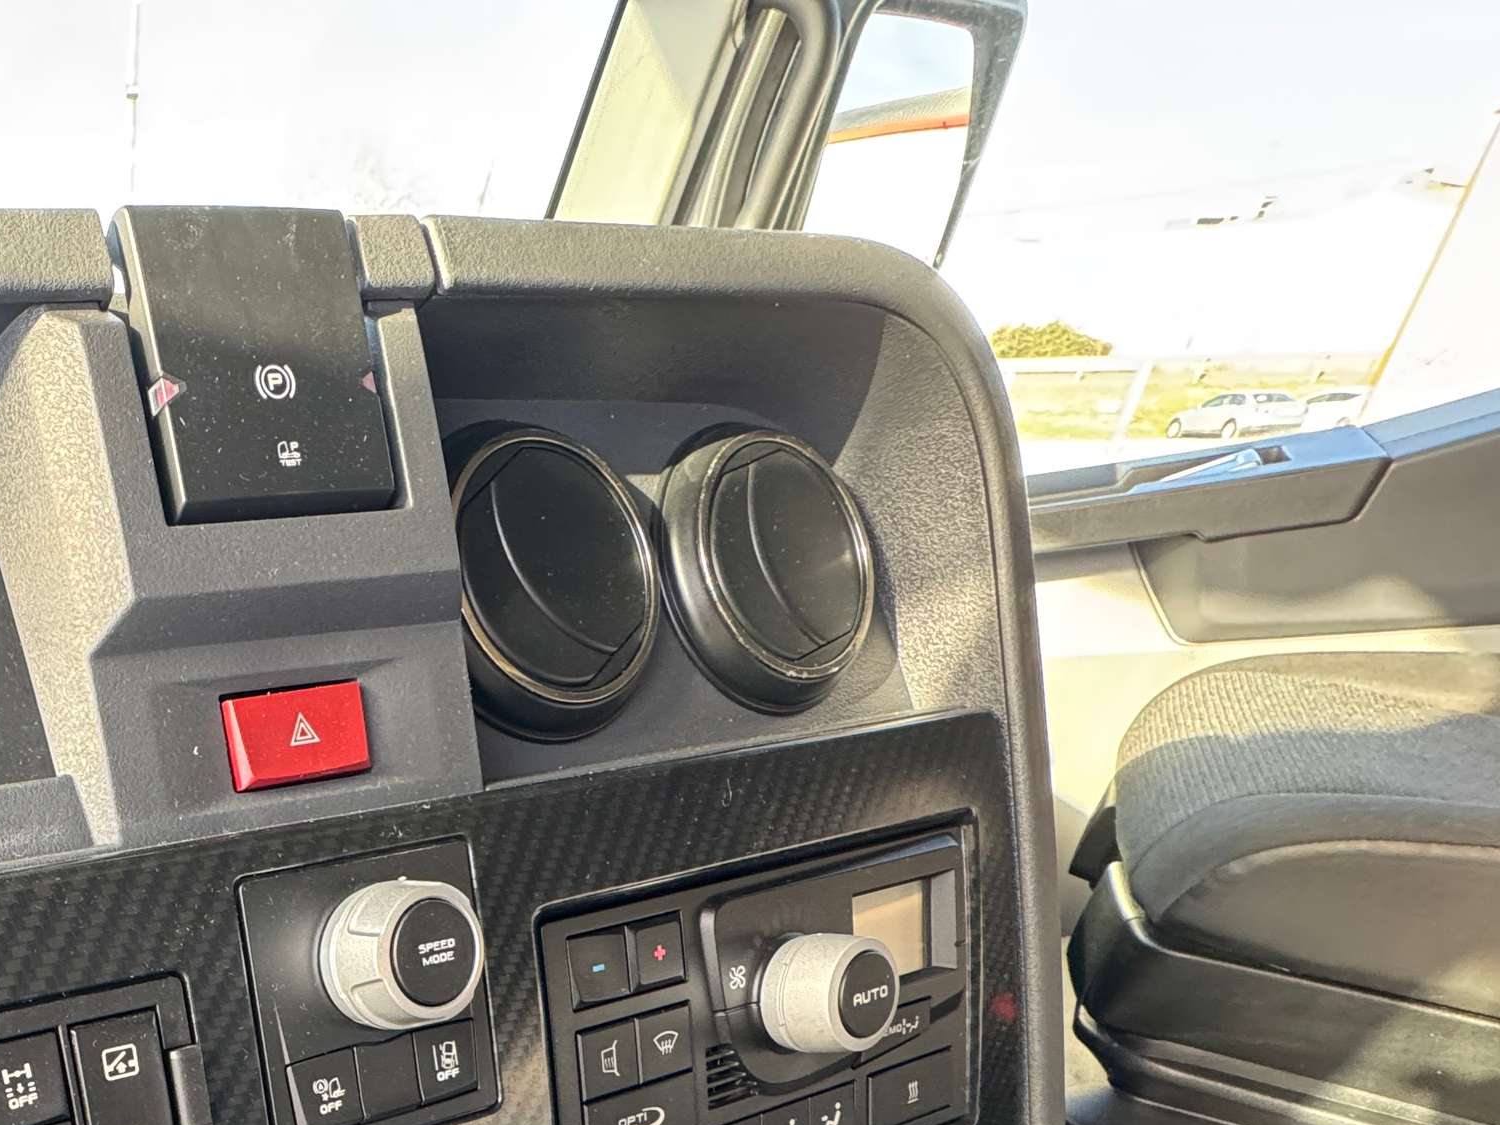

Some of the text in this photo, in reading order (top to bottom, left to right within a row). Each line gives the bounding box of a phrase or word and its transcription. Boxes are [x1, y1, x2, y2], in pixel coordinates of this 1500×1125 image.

[279, 458, 303, 467] TEST
[417, 937, 456, 955] SPEED
[421, 950, 455, 967] MODE
[852, 984, 889, 1007] AUTO
[436, 1067, 460, 1082] OFF
[9, 1093, 38, 1110] OFF
[319, 1100, 343, 1115] OFF
